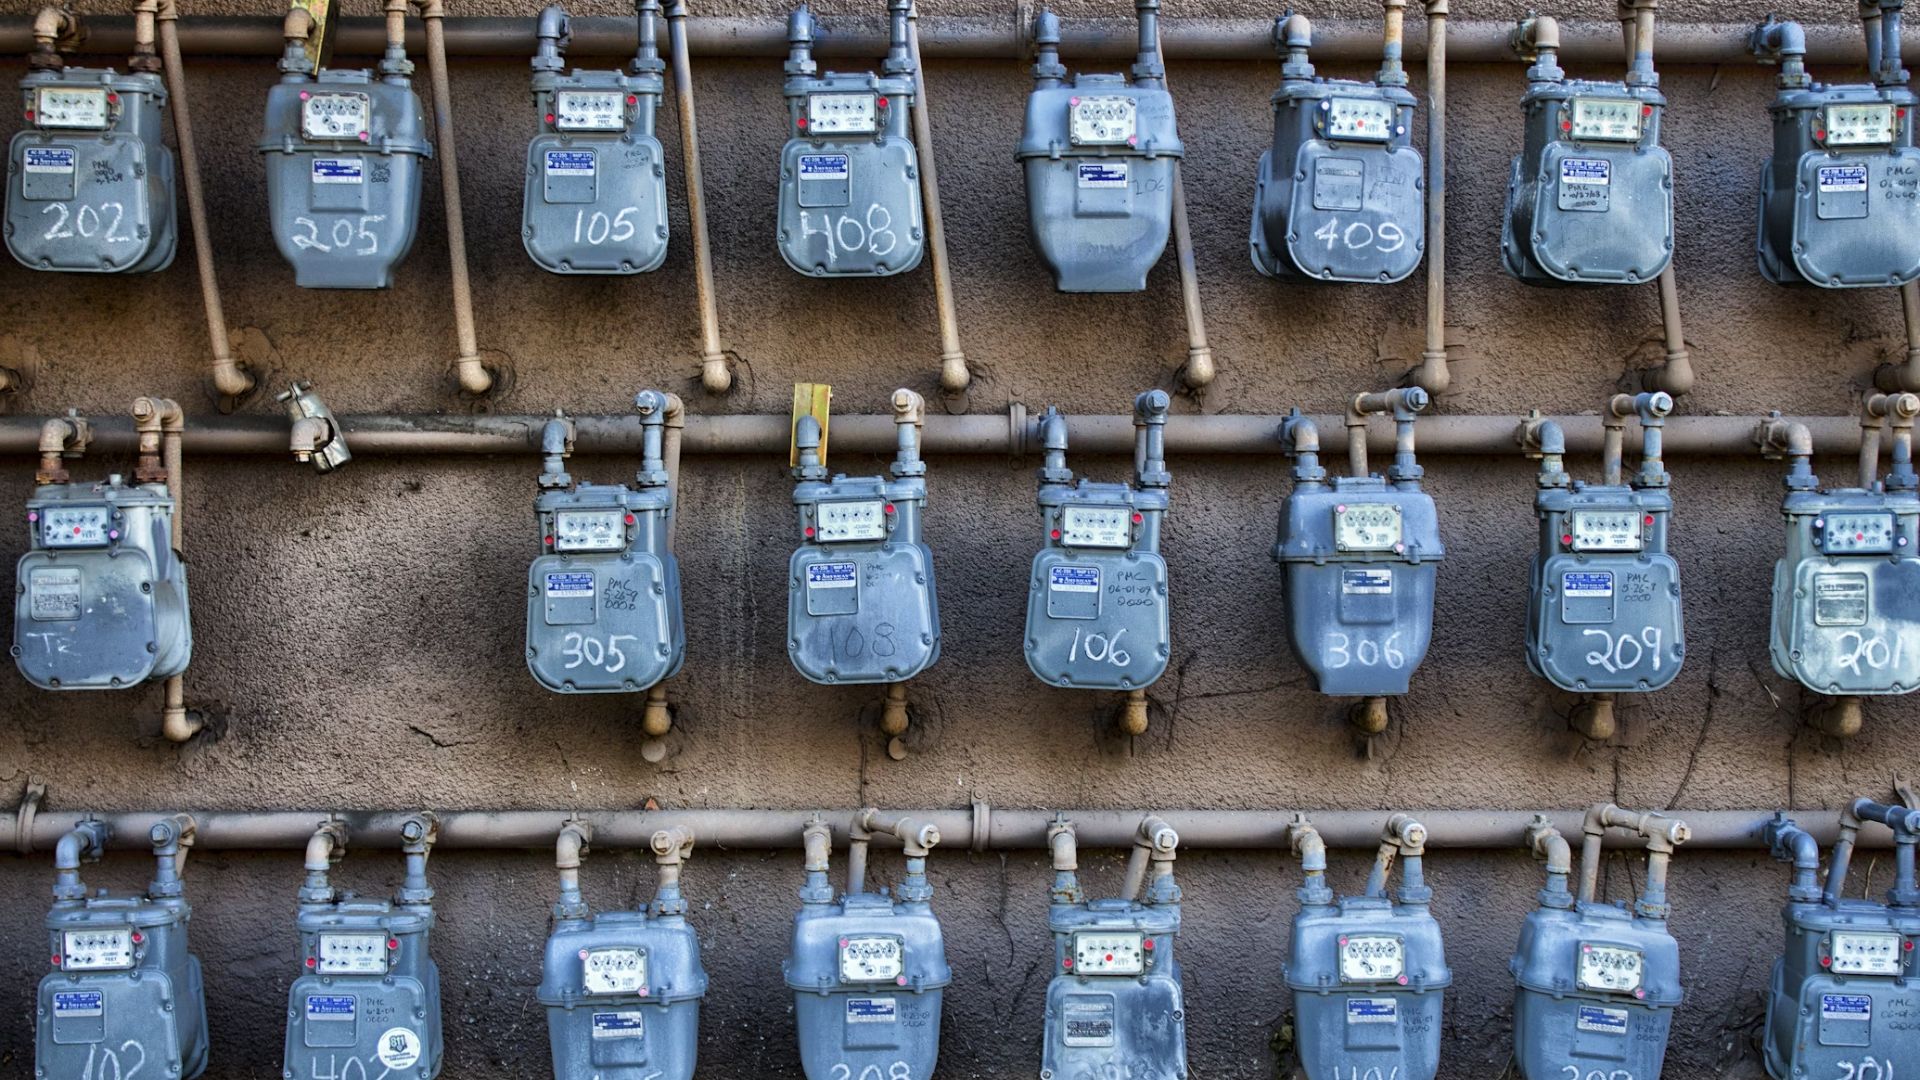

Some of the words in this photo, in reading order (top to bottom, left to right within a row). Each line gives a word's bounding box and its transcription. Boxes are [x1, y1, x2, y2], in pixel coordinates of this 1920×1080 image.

[42, 202, 130, 242] 202
[292, 214, 387, 256] 205
[574, 206, 639, 245] 105
[1314, 217, 1405, 252] 409
[608, 577, 633, 588] PMC
[1117, 572, 1148, 582] PMC
[1626, 572, 1648, 582] PMC
[562, 632, 638, 672] 305
[830, 622, 896, 664] 108
[1068, 627, 1130, 666] 106
[1324, 631, 1404, 669] 306
[1836, 630, 1903, 676] 201
